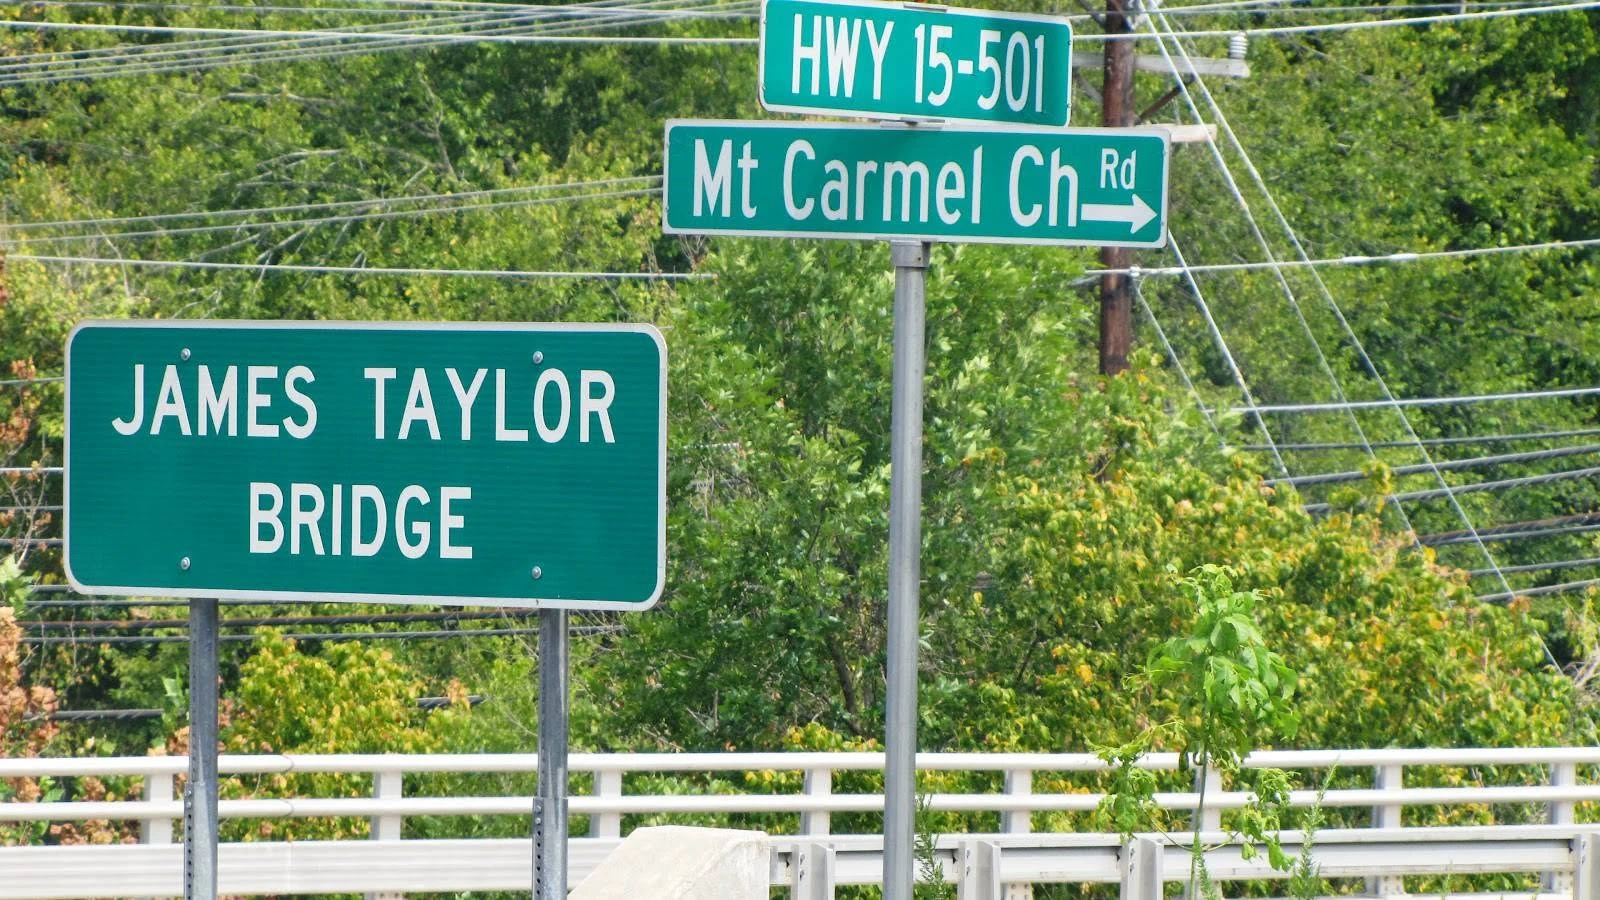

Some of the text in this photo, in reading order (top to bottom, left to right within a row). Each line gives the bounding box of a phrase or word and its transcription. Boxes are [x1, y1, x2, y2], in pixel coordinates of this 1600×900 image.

[791, 13, 1046, 112] HWY 15-501
[693, 138, 1137, 227] Mt Carmel Ch Rd
[111, 363, 617, 444] JAMES TAYLOR
[249, 481, 474, 560] BRIDGE
